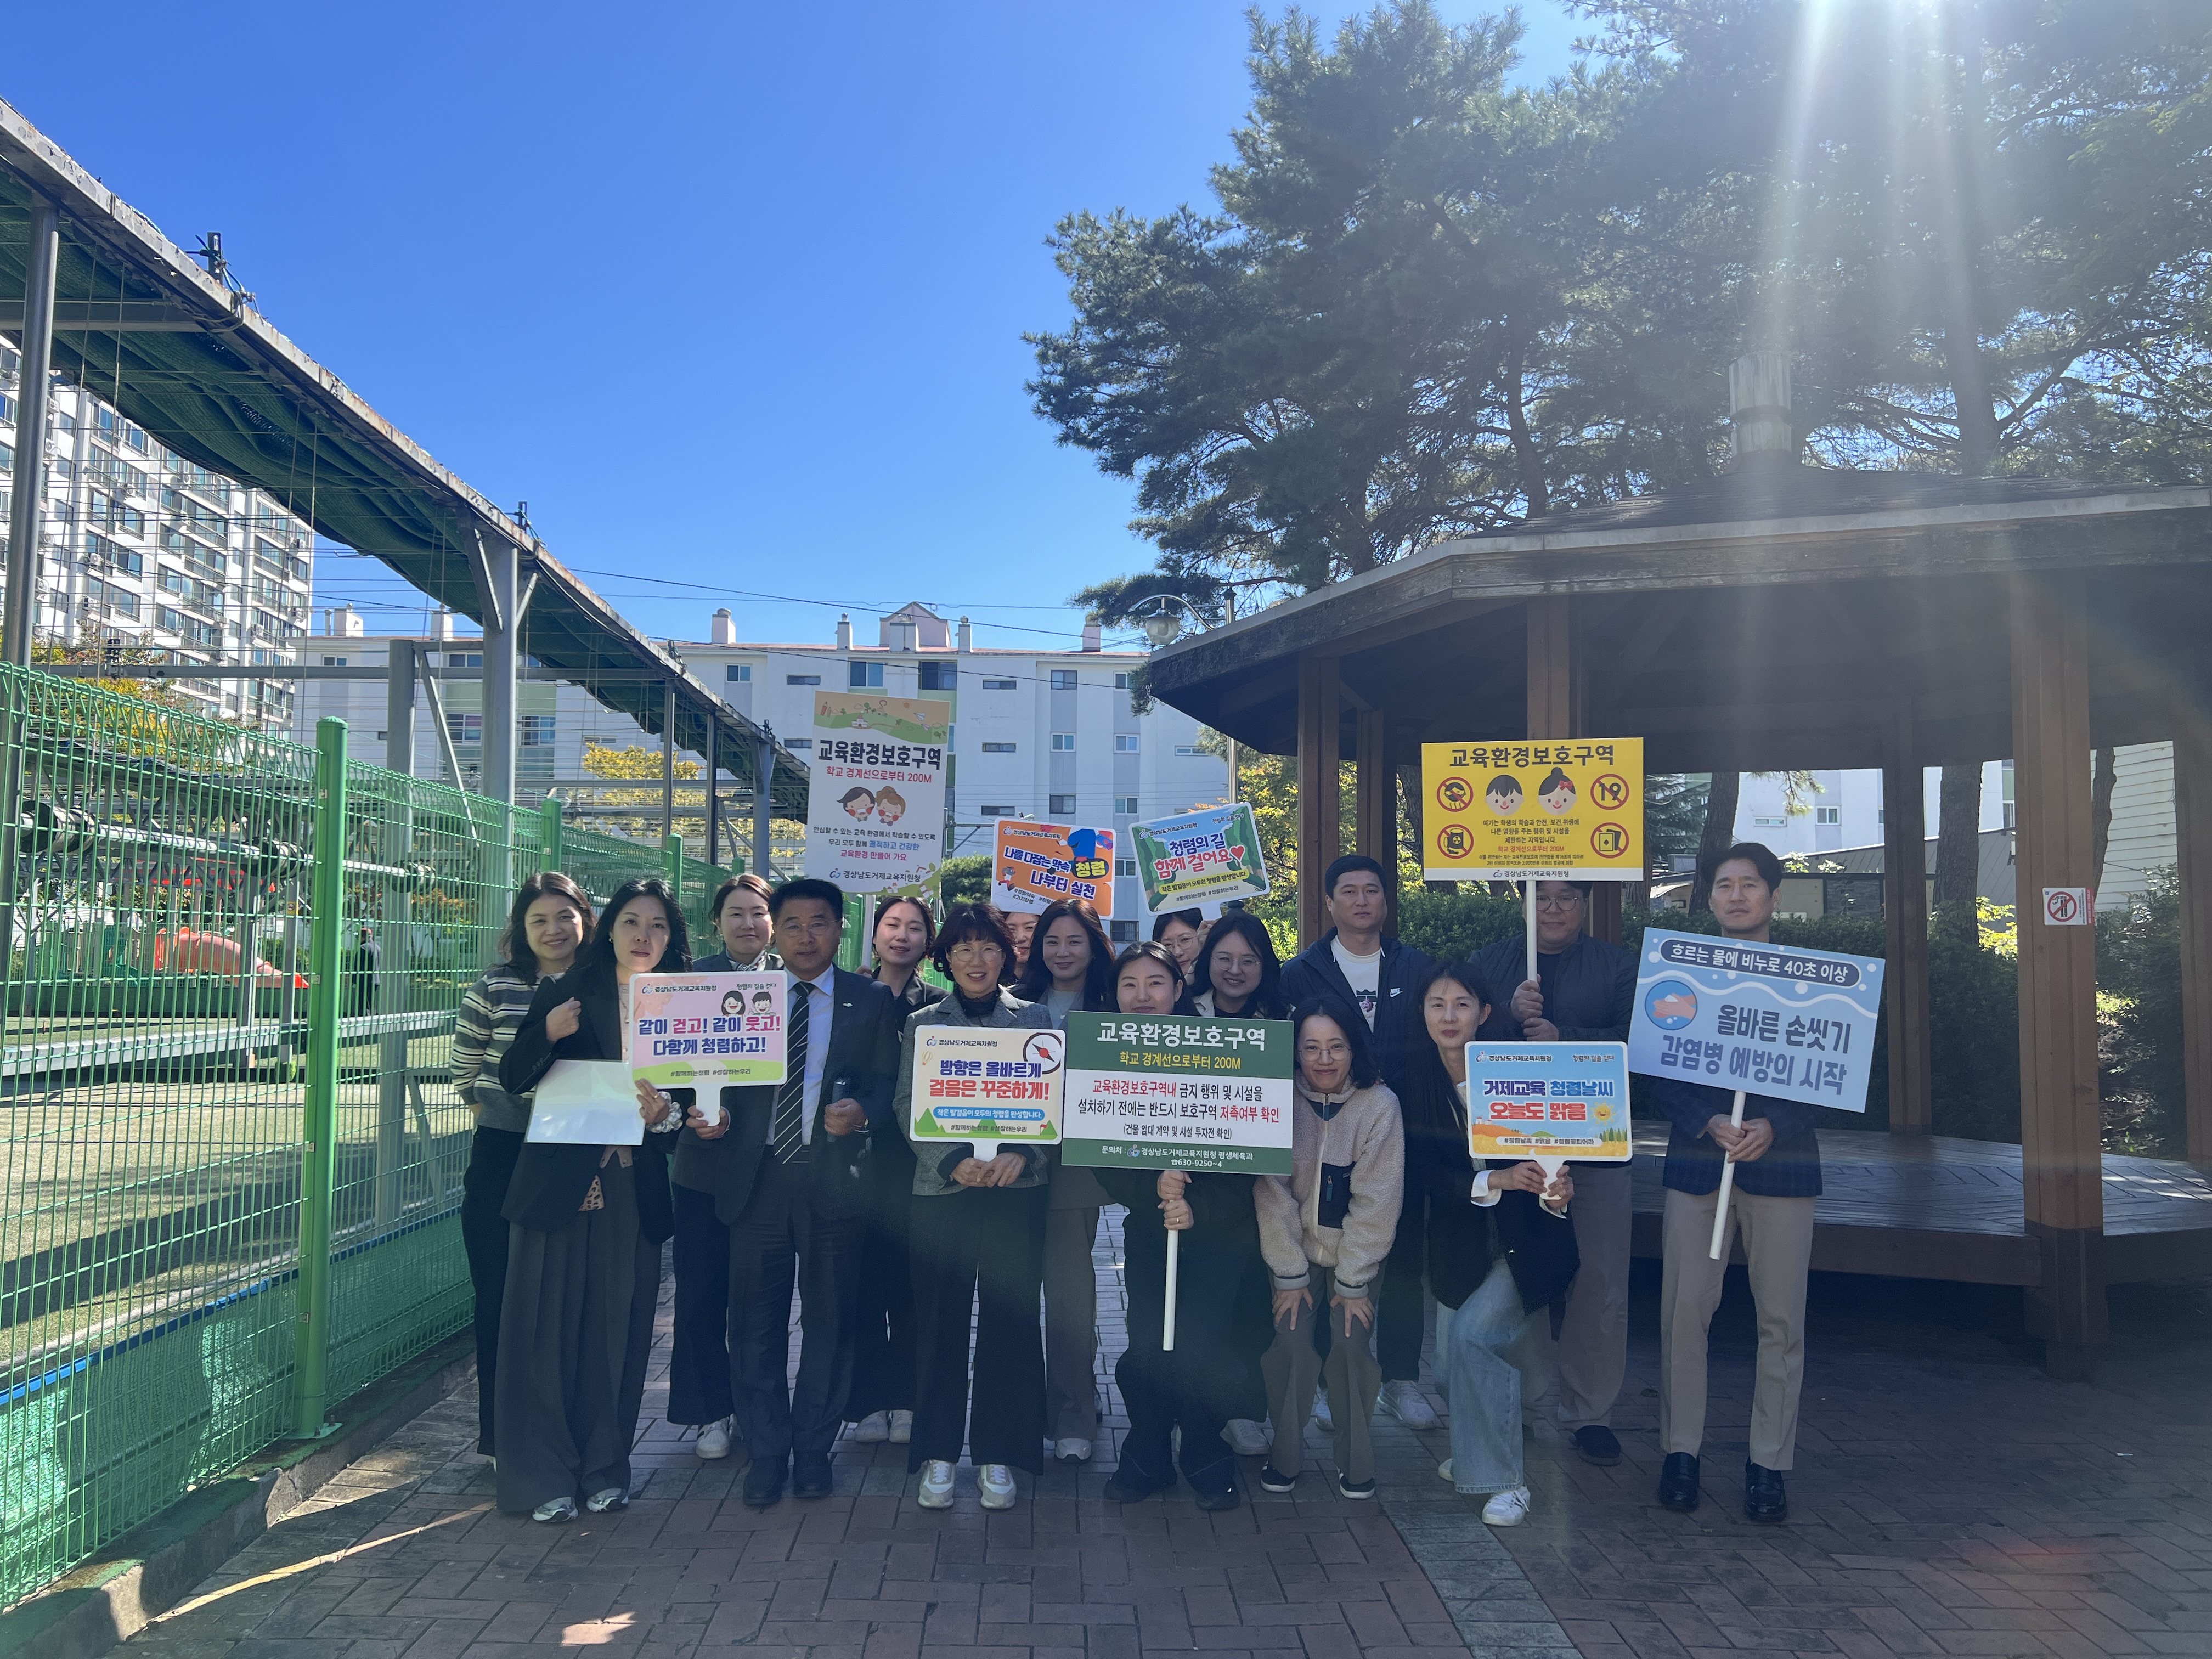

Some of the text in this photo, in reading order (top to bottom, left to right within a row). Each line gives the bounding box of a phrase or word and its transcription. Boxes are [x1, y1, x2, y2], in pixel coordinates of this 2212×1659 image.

[819, 740, 941, 770] 교육환경보호구역
[1449, 745, 1614, 768] 교육환경보호구역
[826, 766, 932, 783] 학교 경계선으로부터 200M
[867, 830, 890, 838] 환경에서
[1013, 830, 1061, 839] 경상남도거제교육지원청
[1149, 823, 1198, 836] 경상남도거제교육지원청
[869, 840, 896, 849] 쾌적하고
[899, 842, 919, 850] 건강한
[1170, 833, 1226, 856] 청렴의 길
[840, 850, 868, 859] 교육환경
[871, 851, 890, 860] 만들어
[1005, 847, 1105, 877] 나를 다잡는 약속 청렴
[1154, 849, 1231, 878] 함께 걸어요
[843, 871, 921, 882] 경상남도거제교육지원청
[1031, 871, 1096, 899] 나부터 실천
[1671, 944, 1848, 983] 흐르는 물에 비누로 40초 이상
[640, 1016, 780, 1035] 같이 걷고! 같이 웃고!
[1717, 1005, 1852, 1054] 올바른 손씻기
[1097, 1022, 1265, 1051] 교육환경보호구역
[653, 1037, 766, 1056] 다함께 청렴하고!
[940, 1060, 1041, 1078] 방향은 올바르게
[1120, 1051, 1240, 1069] 학교 경계선으로부터 200M
[1661, 1035, 1847, 1096] 감염병 예방의 시작
[929, 1080, 1049, 1101] 걸음은 꾸준하게!
[1093, 1080, 1263, 1102] 교육환경보호구역내 금지 행위 및 시설을
[1484, 1080, 1613, 1096] 거제교육 청렴날씨
[950, 1109, 973, 1117] 발걸음이
[992, 1110, 1009, 1119] 청렴을
[1011, 1111, 1042, 1119] 완성합니다.
[1078, 1099, 1279, 1123] 설치하기 전에는 반드시 보호구역 저촉여부 확인
[1490, 1102, 1585, 1120] 오늘도 맑음
[1124, 1123, 1232, 1140] (건물 임대 계약 및 시설 투자전 확인)
[1102, 1146, 1122, 1154] 문의처
[1141, 1147, 1216, 1159] 경상남도거제교육지원청
[1218, 1150, 1252, 1160] 평생체육과
